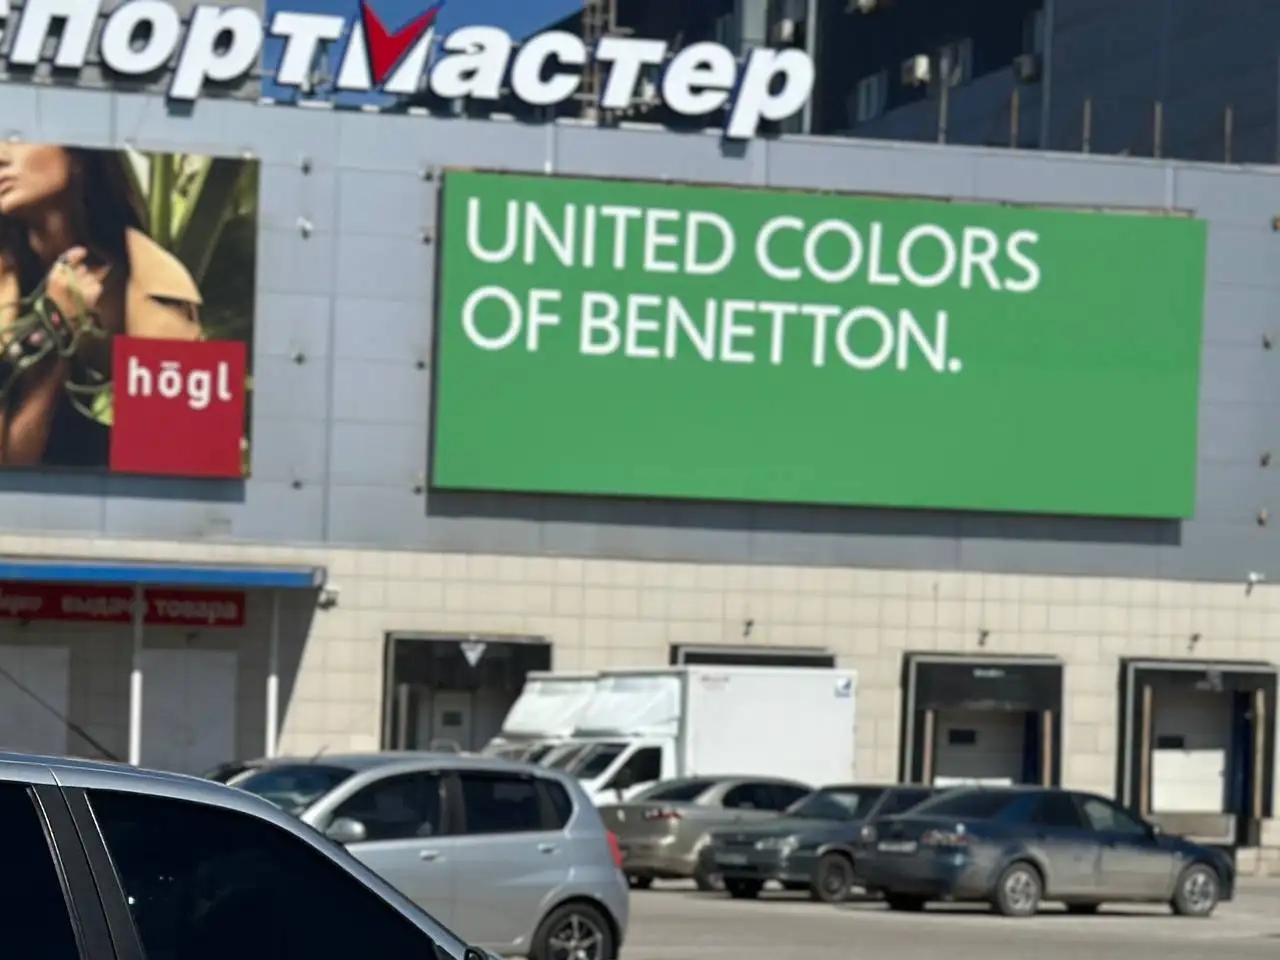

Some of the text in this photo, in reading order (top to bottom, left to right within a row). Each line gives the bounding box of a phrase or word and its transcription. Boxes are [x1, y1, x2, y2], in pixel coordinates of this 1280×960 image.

[466, 196, 1041, 293] UNITED COLORS
[461, 285, 963, 373] OF BENETTON.
